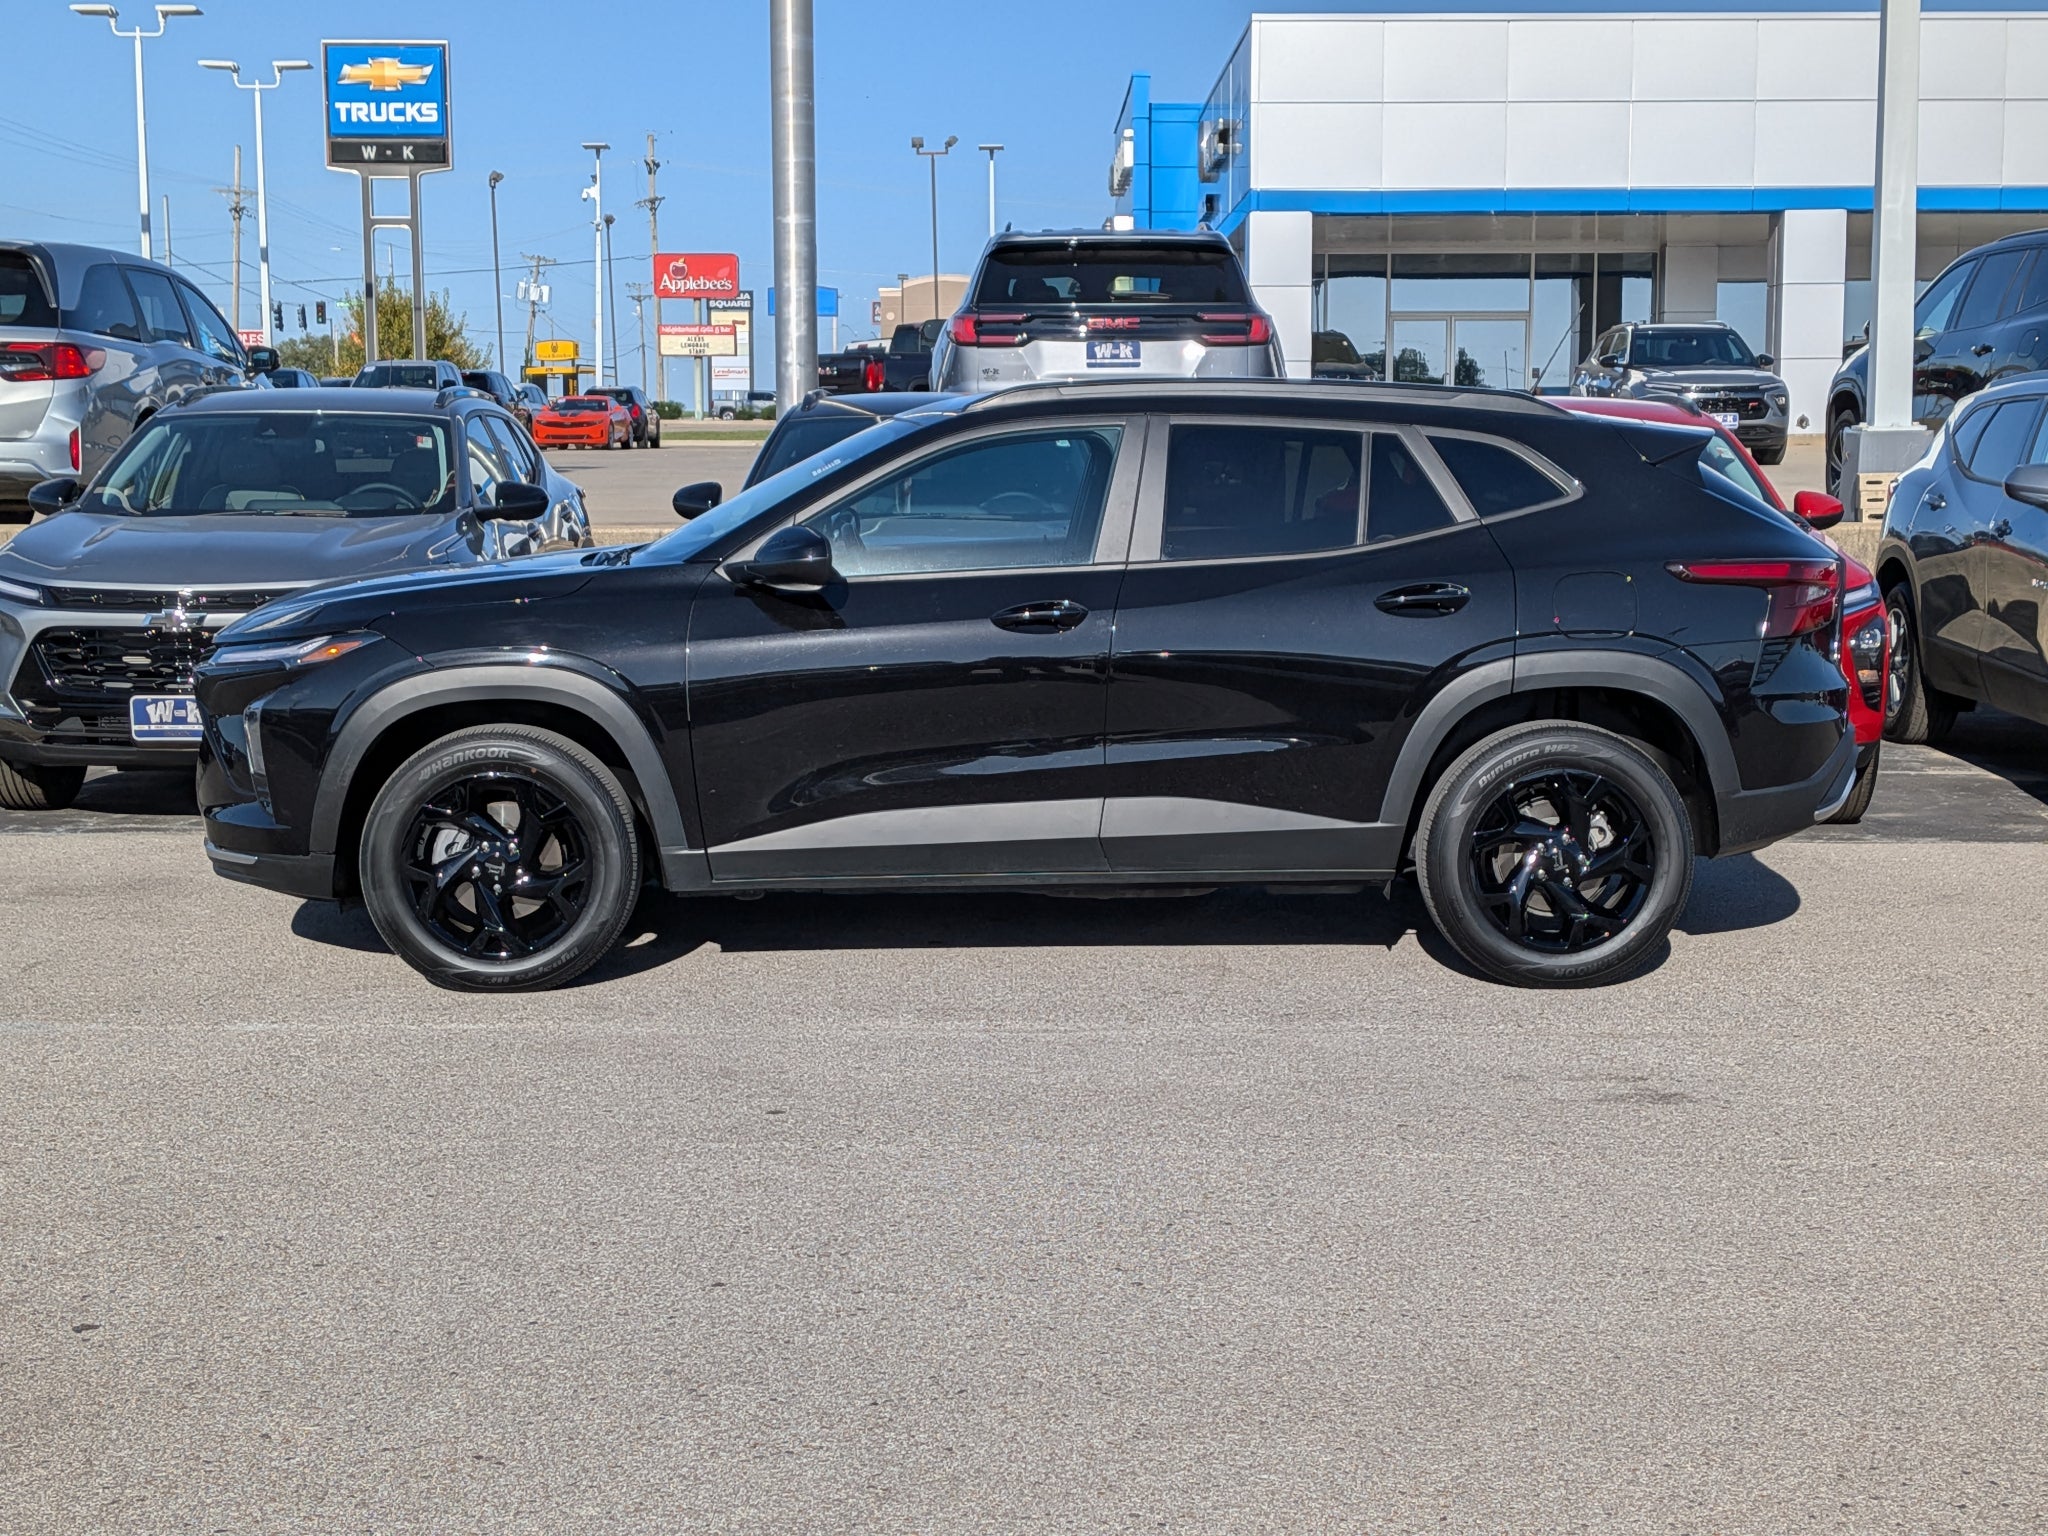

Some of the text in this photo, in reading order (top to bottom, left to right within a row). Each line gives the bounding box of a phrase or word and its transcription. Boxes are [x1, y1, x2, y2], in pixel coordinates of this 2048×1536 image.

[334, 102, 438, 122] TRUCKS
[659, 273, 732, 293] Applebee's
[709, 300, 751, 308] SQUARE
[1088, 317, 1140, 329] GMC
[1094, 342, 1133, 358] W-K
